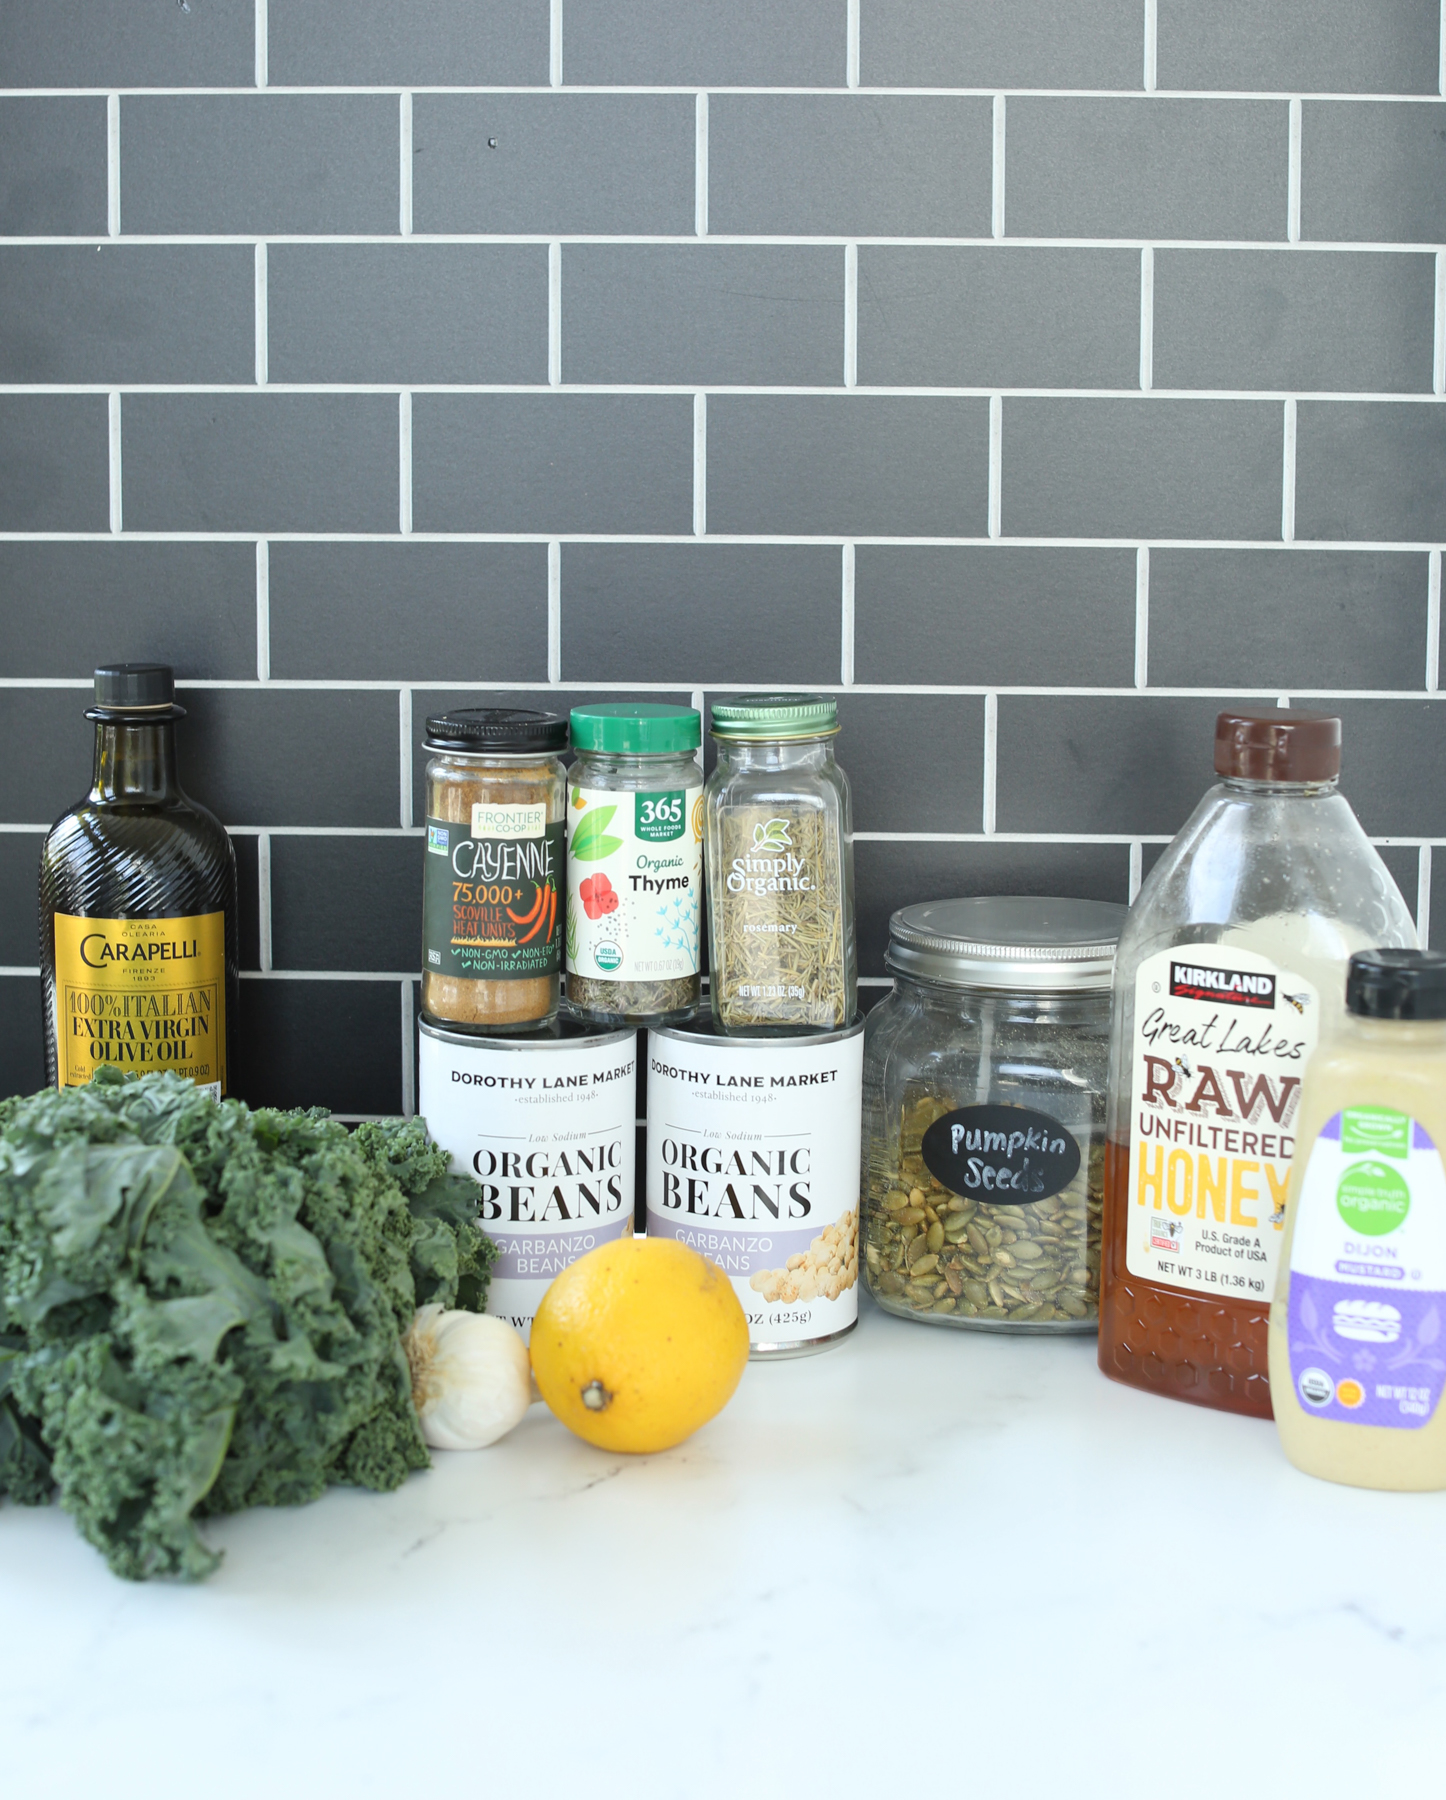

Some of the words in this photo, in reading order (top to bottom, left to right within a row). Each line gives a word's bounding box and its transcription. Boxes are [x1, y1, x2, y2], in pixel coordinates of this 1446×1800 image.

[478, 811, 541, 824] FRONTIER
[640, 797, 682, 824] 365
[495, 824, 527, 833] CO-OP
[452, 840, 554, 882] CAYENNE
[636, 854, 684, 873] Organic
[732, 853, 805, 878] Simply
[628, 874, 689, 895] Thyme
[453, 905, 503, 922] SCOVILLE
[453, 920, 478, 937] HEAT
[481, 922, 516, 938] UNITS
[743, 924, 798, 935] rosemary
[80, 934, 197, 968] CARAPELLI
[461, 948, 508, 960] NON-GMO
[600, 947, 616, 955] USDA
[472, 957, 548, 972] NON-IRRADIATED
[634, 960, 644, 972] NET
[644, 960, 653, 972] WT
[666, 960, 672, 970] OZ
[1174, 965, 1273, 995] KIRKLAND
[738, 985, 750, 997] NET
[762, 985, 776, 997] 1.23
[788, 985, 805, 999] (35g)
[70, 991, 122, 1018] 100%
[122, 990, 212, 1018] ITALIAN
[72, 1016, 136, 1040] EXTRA
[139, 1014, 210, 1040] VIRGIN
[1142, 1007, 1219, 1049] Great
[1216, 1018, 1306, 1060] Lakes
[90, 1040, 154, 1062] OLIVE
[156, 1040, 193, 1060] OIL
[74, 1064, 86, 1072] Cold
[200, 1064, 210, 1076] OZ)
[451, 1070, 538, 1089] DOROTHY
[542, 1074, 588, 1088] LANE
[592, 1060, 635, 1084] MARKET
[651, 1058, 711, 1085] DOROTHY
[716, 1074, 765, 1088] LANE
[770, 1070, 838, 1088] MARKET
[1142, 1054, 1301, 1126] RAW
[528, 1134, 549, 1144] Low
[552, 1131, 587, 1142] Sodium
[703, 1128, 722, 1140] Low
[724, 1131, 763, 1141] Sodium
[950, 1124, 1066, 1158] Pumpkin
[1139, 1112, 1296, 1159] UNFILTERED
[473, 1140, 622, 1178] ORGANIC
[662, 1138, 811, 1176] ORGANIC
[964, 1157, 1044, 1192] Seeds
[662, 1170, 812, 1220] BEANS
[1137, 1140, 1292, 1232] HONEY
[476, 1174, 622, 1222] BEANS
[1340, 1195, 1406, 1214] organic
[495, 1234, 596, 1255] GARBANZO
[675, 1228, 773, 1253] GARBANZO
[1202, 1230, 1220, 1242] U.S.
[1222, 1233, 1250, 1247] Grade
[1254, 1238, 1261, 1248] A
[1195, 1242, 1232, 1258] Product
[1234, 1248, 1244, 1258] of
[1246, 1250, 1268, 1262] USA
[1344, 1242, 1398, 1258] DIJON
[698, 1252, 750, 1270] ANS
[1338, 1261, 1401, 1278] MUSTARD
[1157, 1260, 1175, 1274] NET
[1178, 1266, 1193, 1278] WT
[1196, 1269, 1202, 1280] 3
[1205, 1270, 1217, 1282] LB
[1220, 1273, 1246, 1288] (1.36
[1248, 1278, 1265, 1292] kg)
[768, 1310, 812, 1325] (425g)
[1376, 1384, 1392, 1399] NET
